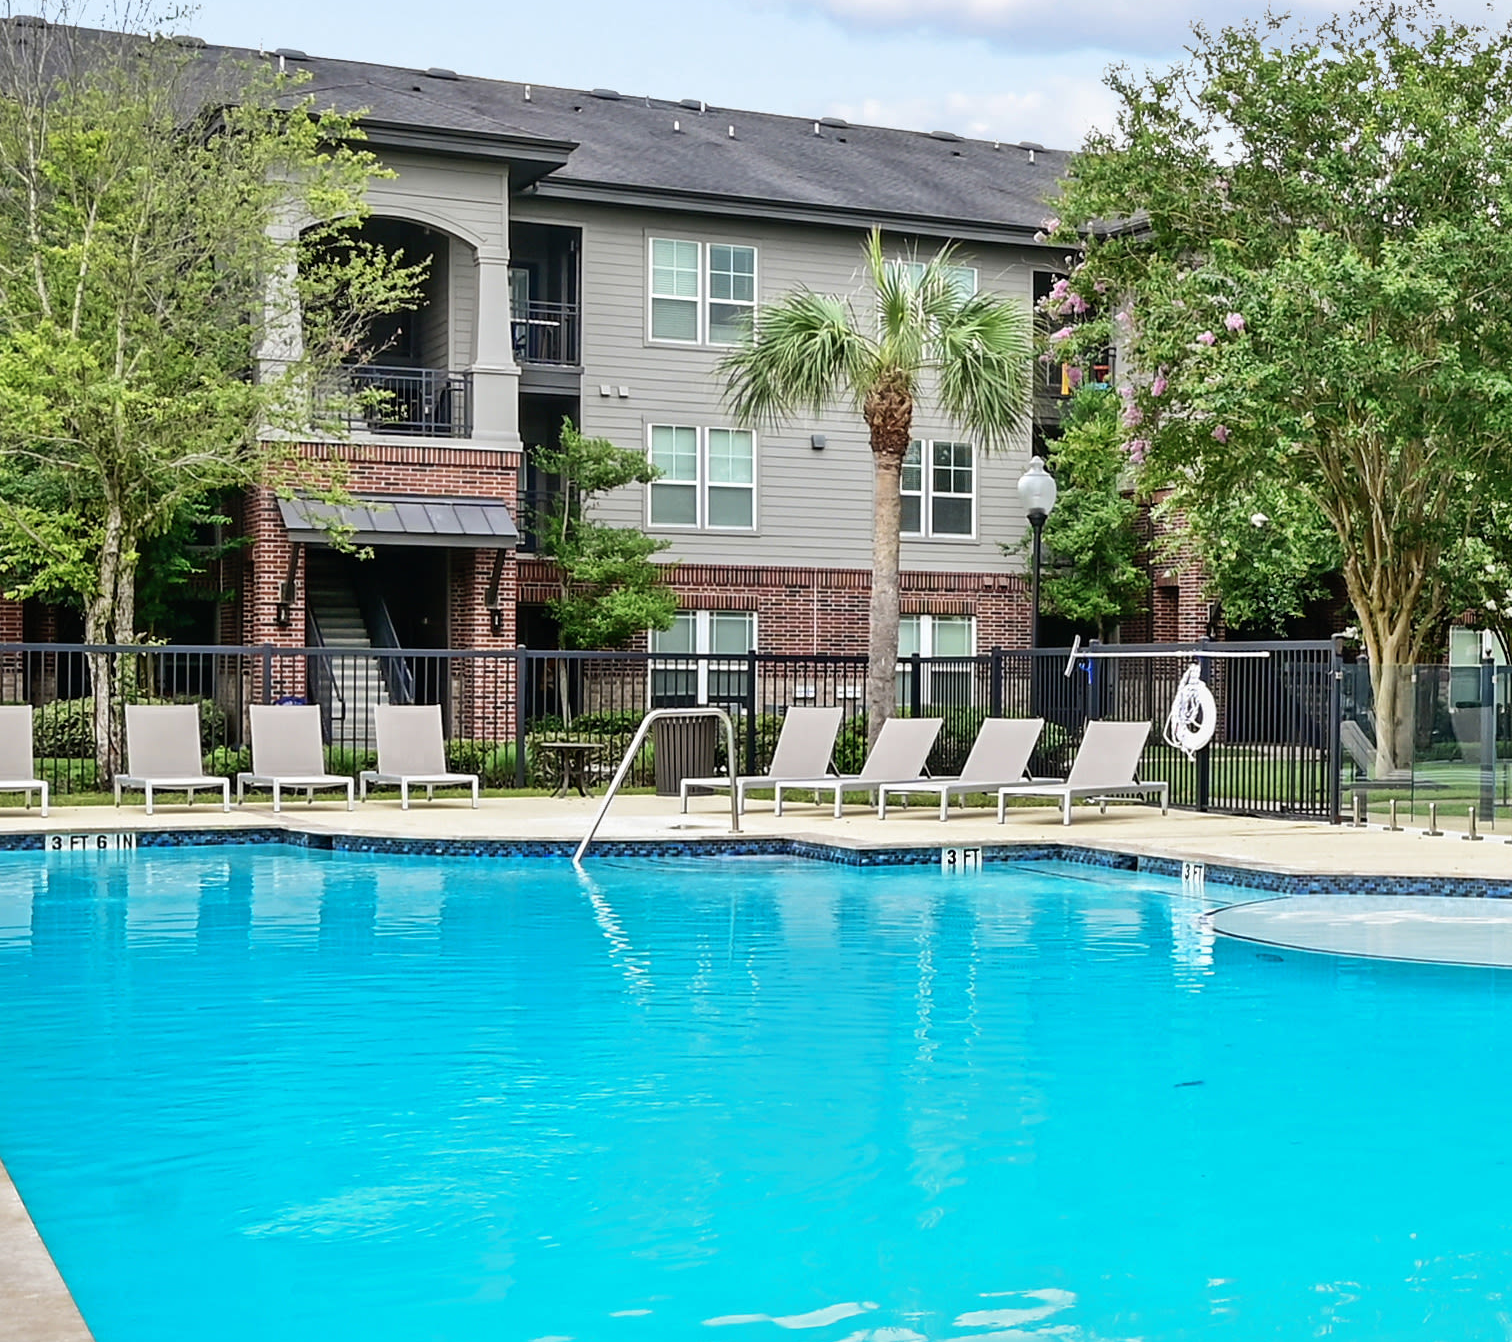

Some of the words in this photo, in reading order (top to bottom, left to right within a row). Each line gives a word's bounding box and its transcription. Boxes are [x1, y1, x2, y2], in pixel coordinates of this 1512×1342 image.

[51, 836, 62, 850] 3
[70, 835, 89, 850] FT
[96, 835, 107, 849] 6
[116, 834, 133, 850] IN
[947, 849, 957, 864] 3
[963, 848, 980, 866] FT
[1184, 864, 1190, 879] 3
[1193, 865, 1203, 880] FT
